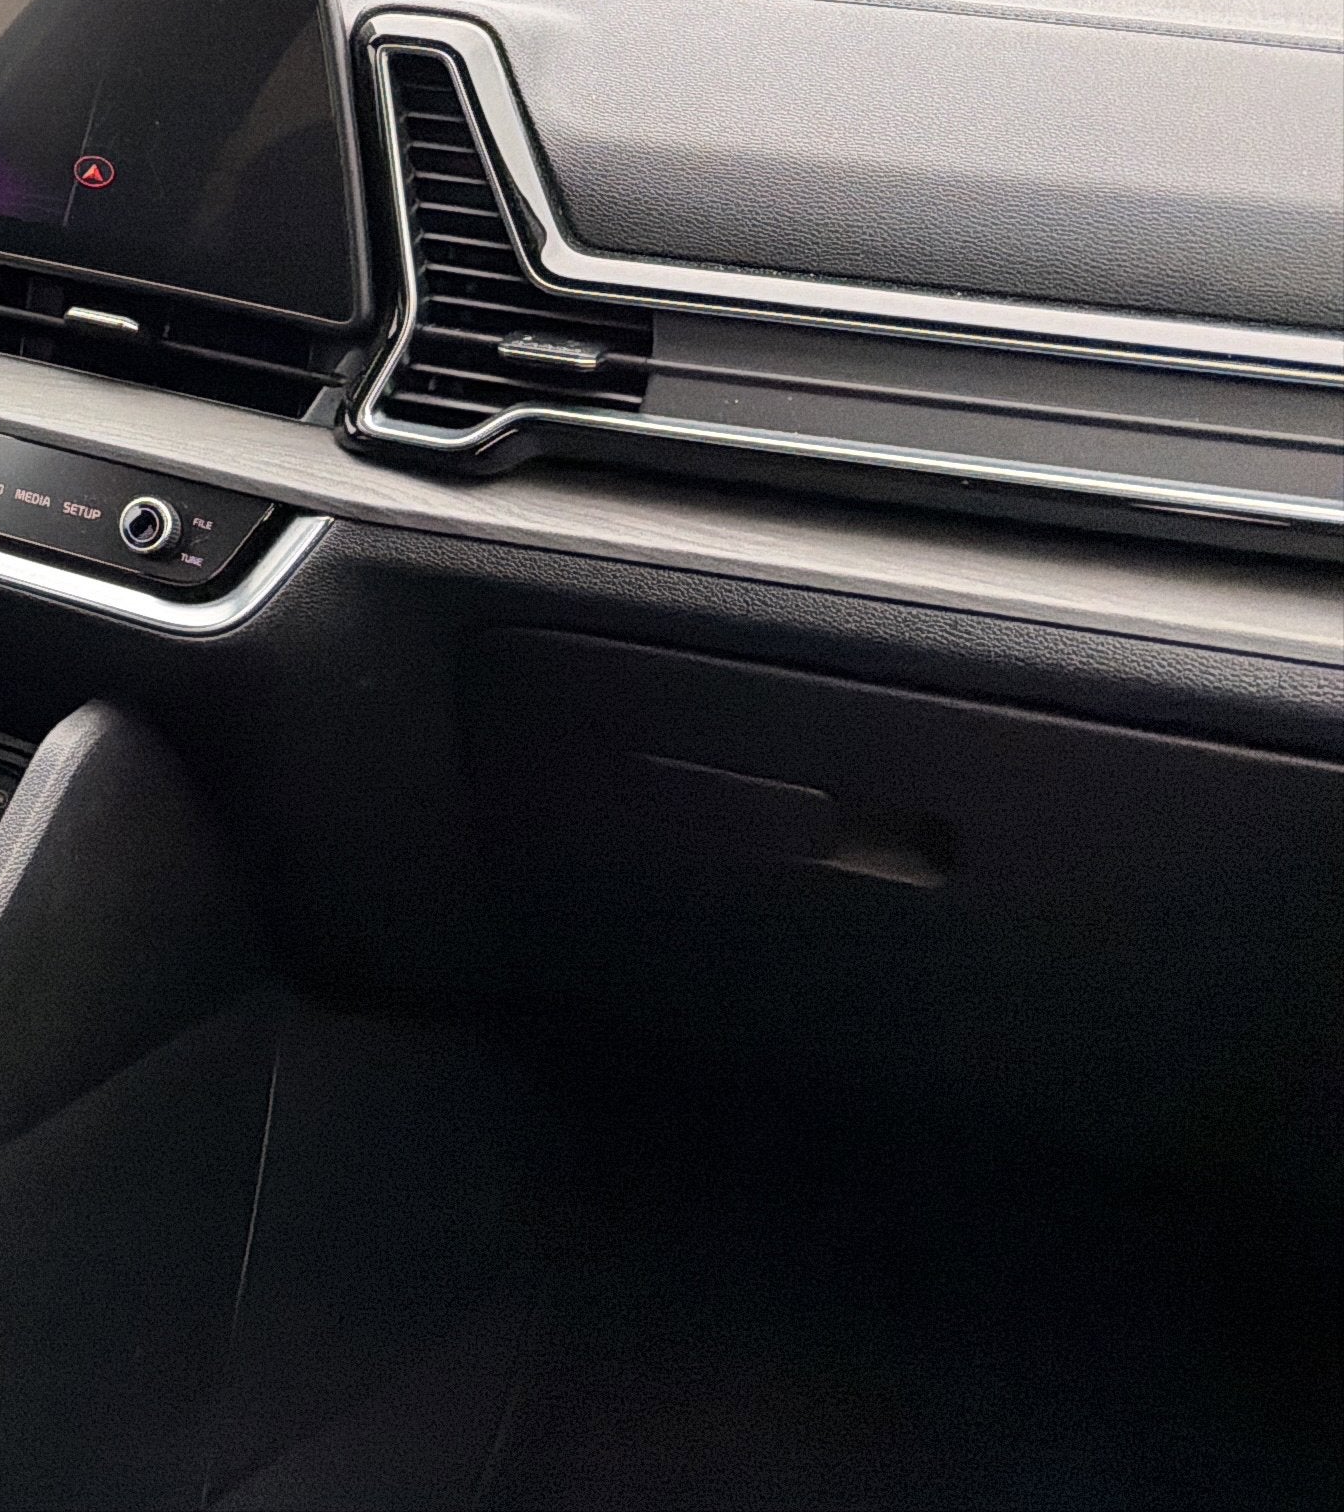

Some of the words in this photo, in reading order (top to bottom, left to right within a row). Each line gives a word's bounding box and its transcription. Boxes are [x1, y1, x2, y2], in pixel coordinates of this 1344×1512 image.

[14, 488, 51, 508] MEDIA
[62, 501, 102, 521] SETUP
[192, 516, 213, 530] FILE
[180, 552, 205, 568] TUNE
